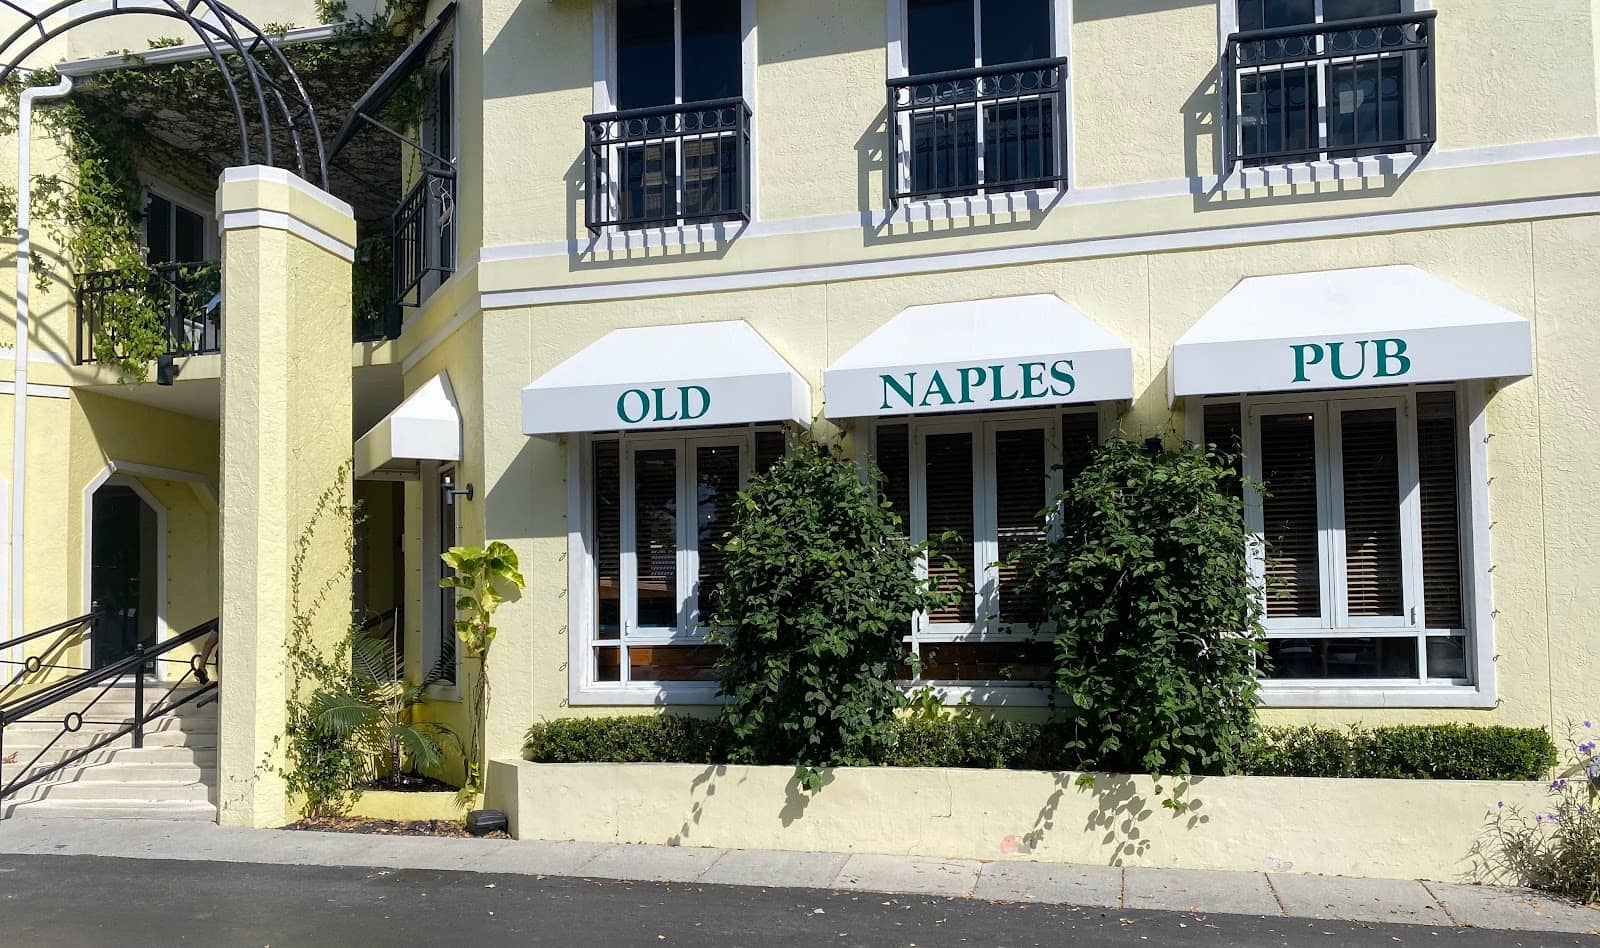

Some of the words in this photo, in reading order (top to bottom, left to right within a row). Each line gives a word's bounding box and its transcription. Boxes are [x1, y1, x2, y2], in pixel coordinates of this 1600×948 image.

[1289, 338, 1411, 384] PUB
[616, 386, 711, 424] OLD
[880, 360, 1076, 410] NAPLES
